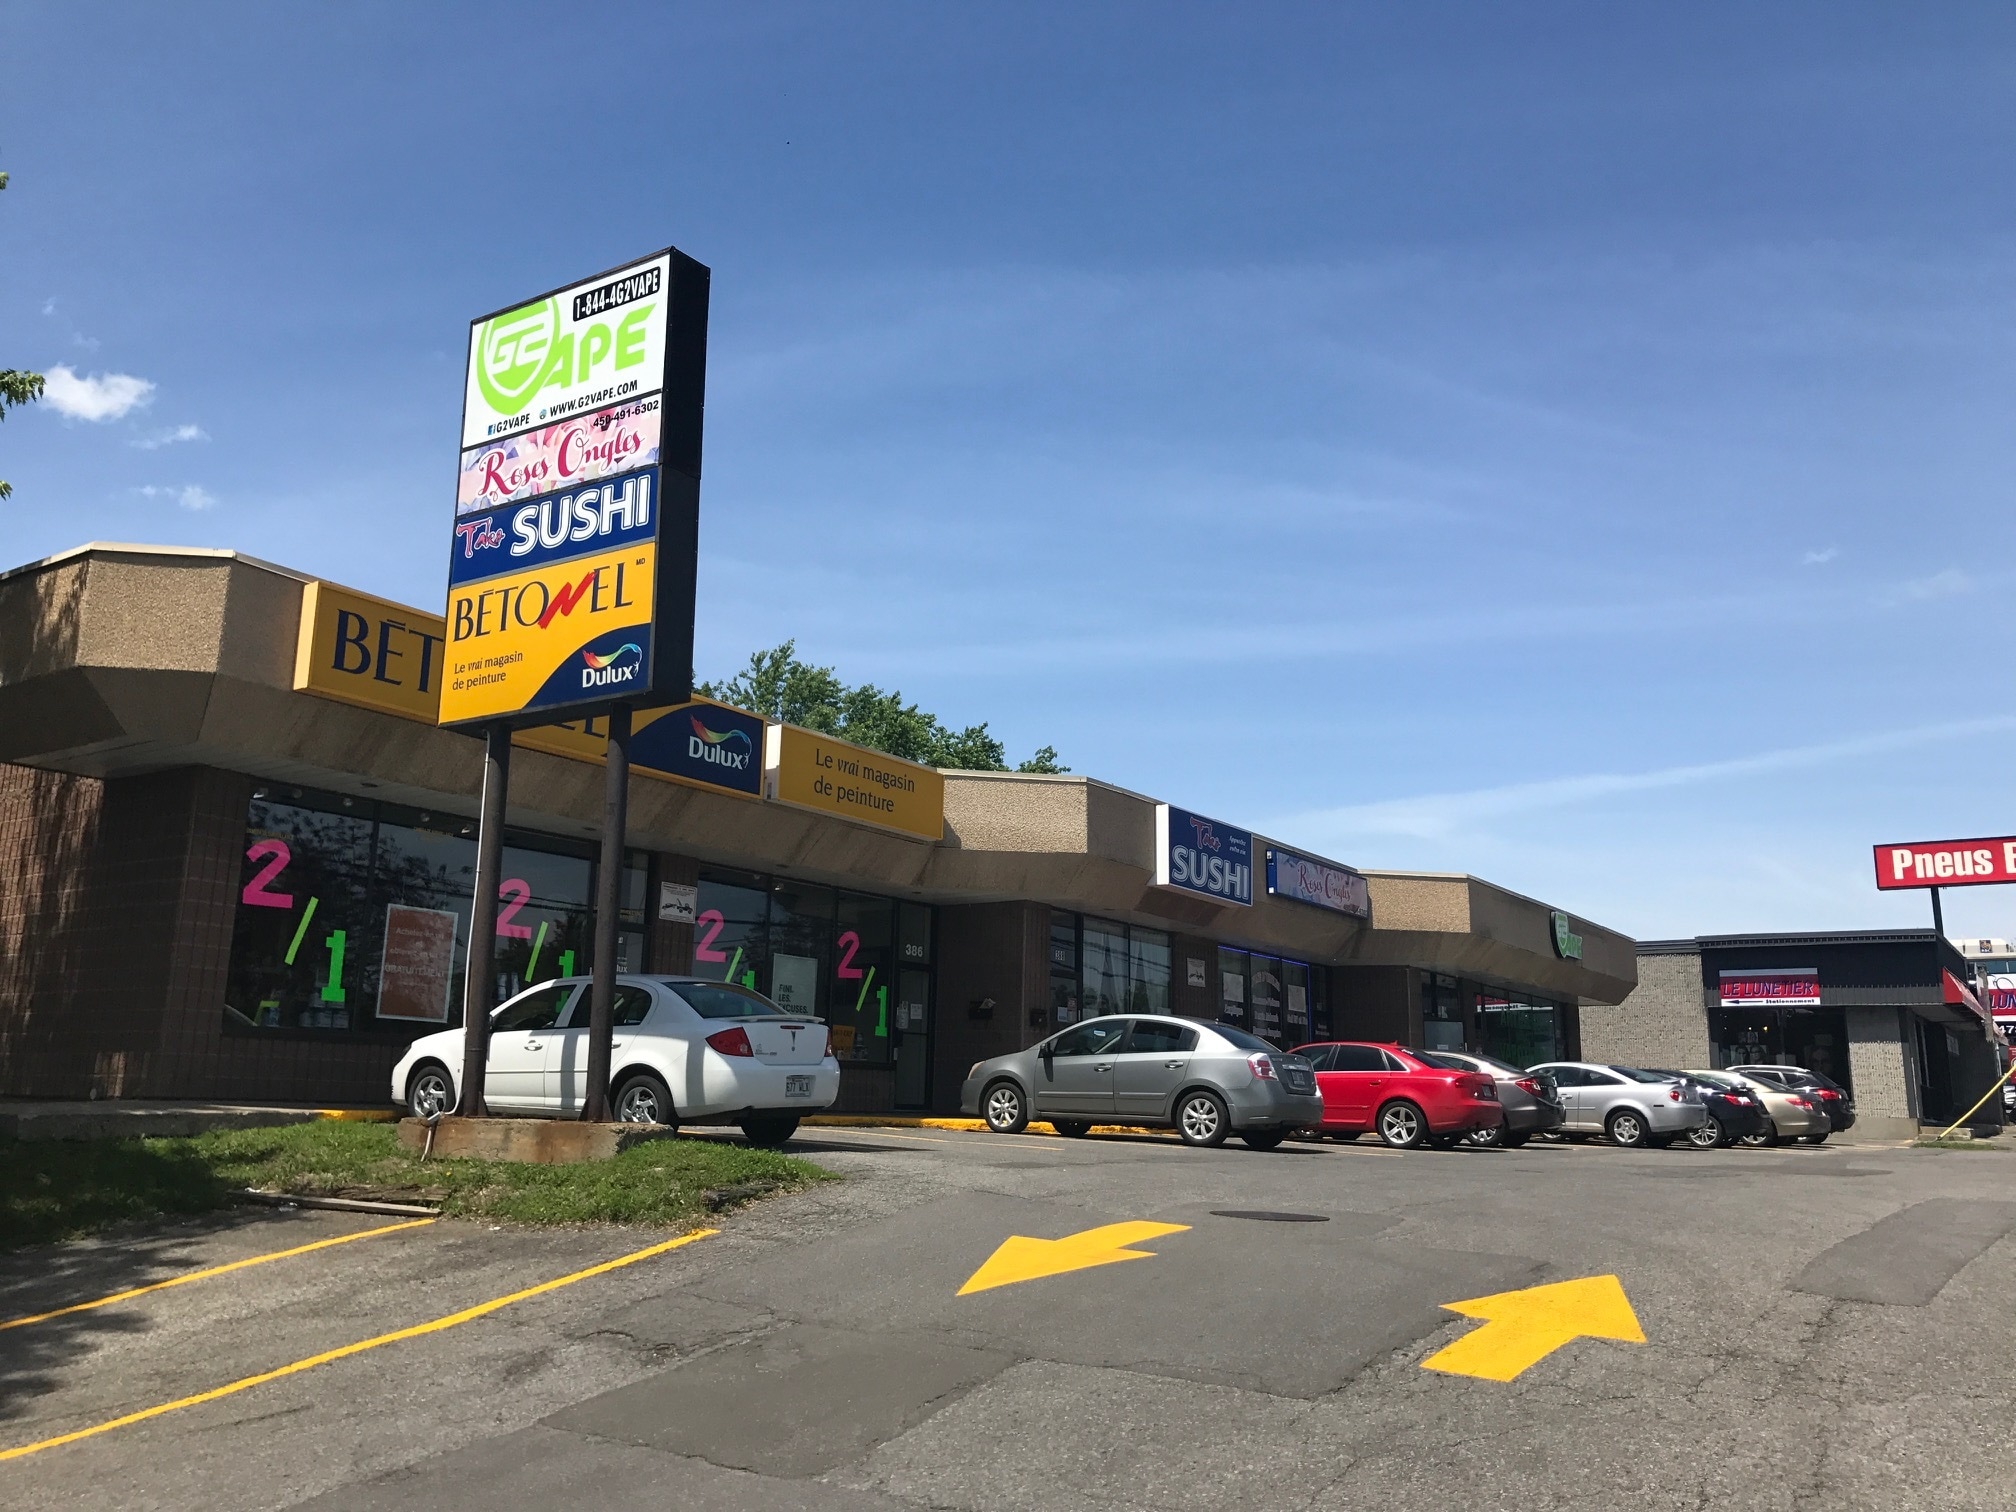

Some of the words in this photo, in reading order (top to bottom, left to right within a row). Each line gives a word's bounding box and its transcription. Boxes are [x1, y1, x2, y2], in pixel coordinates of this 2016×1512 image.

[575, 269, 659, 319] 1-844-4G2VAPE
[550, 380, 638, 417] WWW.G2VAPE.COM
[593, 400, 659, 428] 450-491-6302
[497, 413, 530, 433] G2VAPE
[478, 451, 552, 501] Roses
[557, 427, 646, 478] Ongles
[510, 475, 651, 556] SUSHI
[454, 663, 466, 674] Le
[468, 657, 483, 671] vrai
[484, 650, 523, 668] magasin
[582, 665, 633, 688] Dulux
[452, 678, 465, 690] de
[466, 672, 506, 690] peinture
[688, 735, 743, 770] Dulux
[816, 748, 833, 769] Le
[837, 758, 859, 777] vrai
[862, 765, 915, 792] magasin
[814, 775, 833, 796] de
[836, 786, 894, 812] peinture
[1171, 844, 1249, 900] SUSHI
[1891, 848, 1994, 880] Pneus
[905, 944, 923, 957] 386
[1724, 981, 1741, 997] LE
[1743, 980, 1815, 997] LUNETIER
